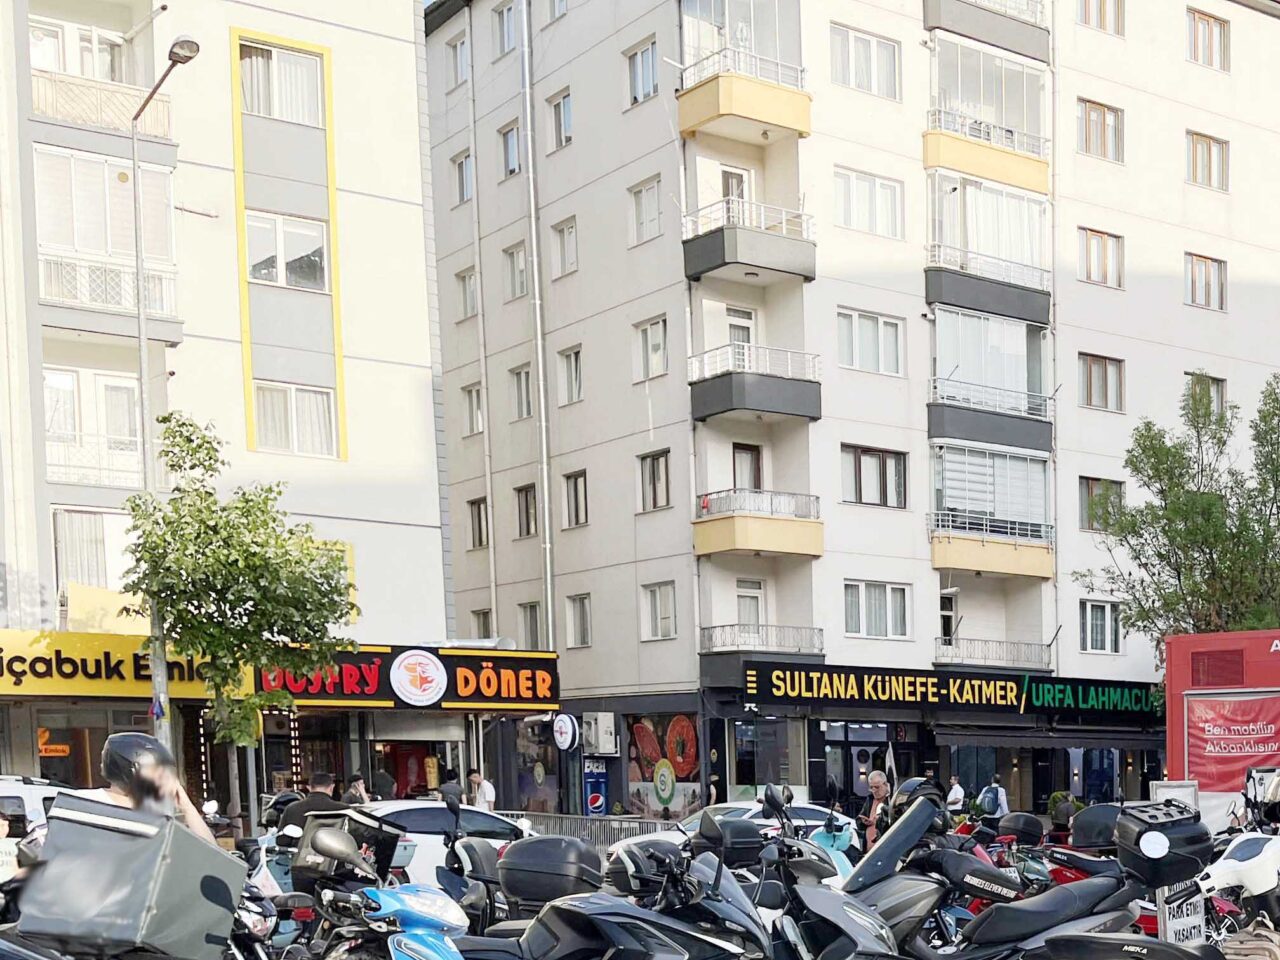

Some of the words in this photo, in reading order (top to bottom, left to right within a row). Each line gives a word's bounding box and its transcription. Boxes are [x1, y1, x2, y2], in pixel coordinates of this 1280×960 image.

[772, 670, 859, 699] SULTANA
[1032, 683, 1074, 708] URFA
[1078, 686, 1158, 712] LAHMACU
[1168, 903, 1184, 921] PARK
